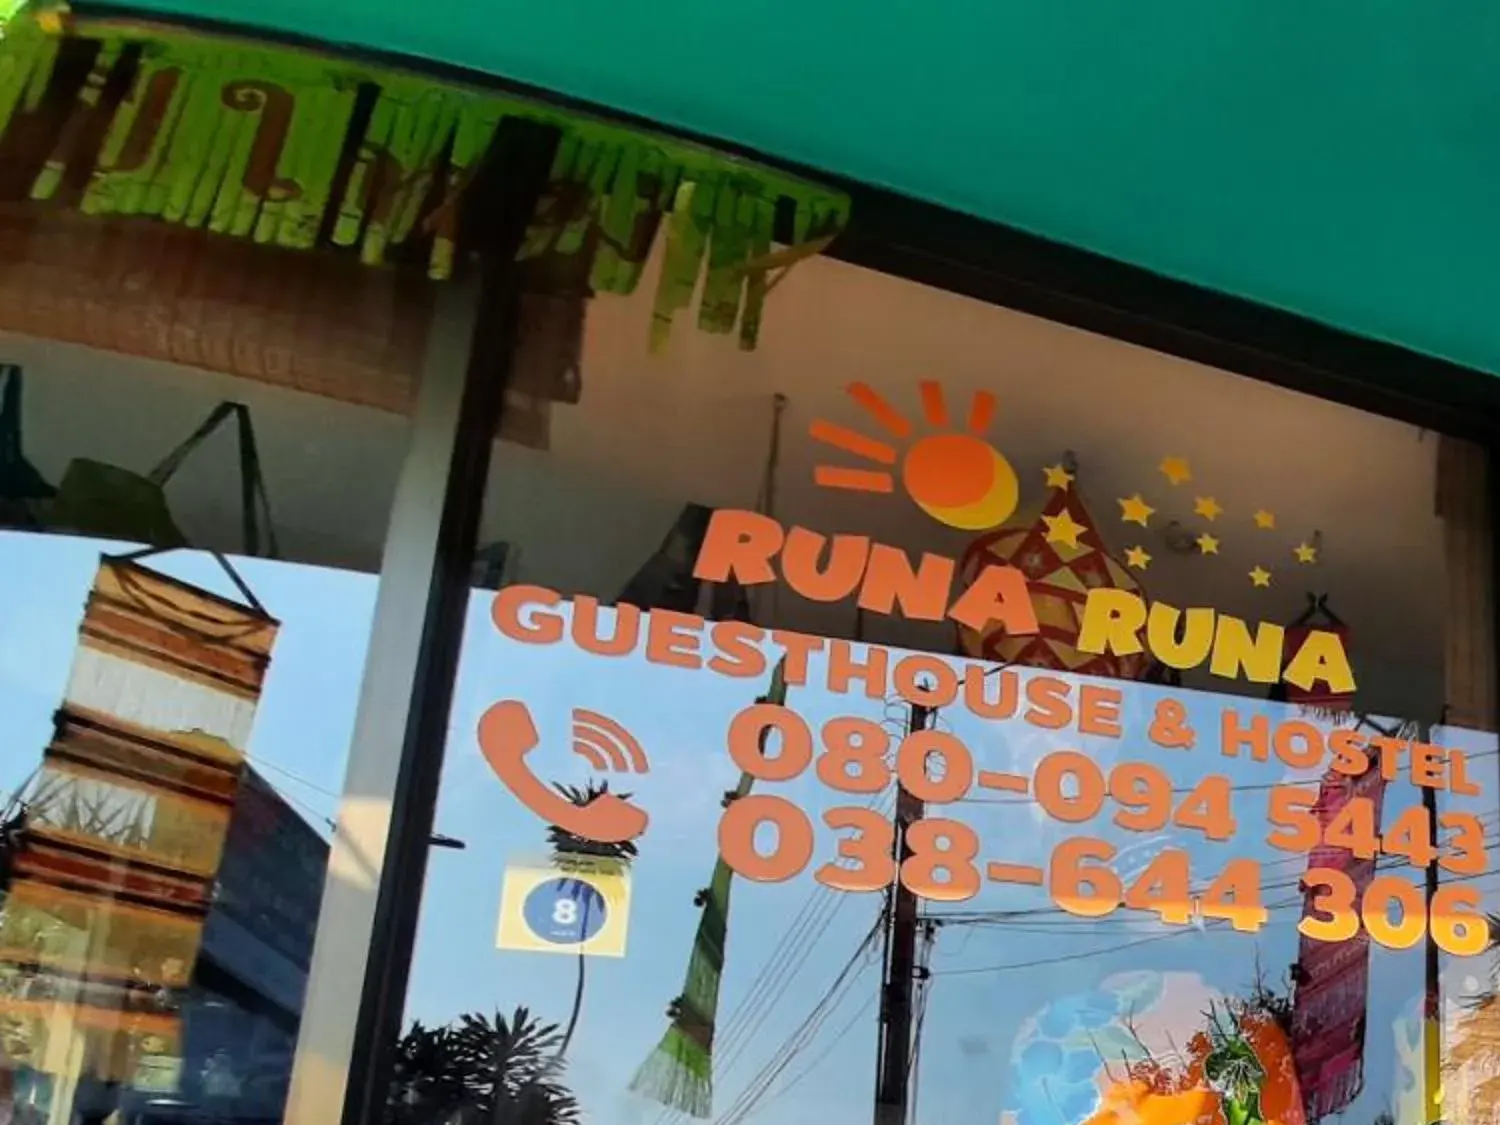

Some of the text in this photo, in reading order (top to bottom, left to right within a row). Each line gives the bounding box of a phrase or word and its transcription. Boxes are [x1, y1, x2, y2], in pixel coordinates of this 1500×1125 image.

[491, 585, 1482, 797] GUESTHOUSE & HOSTEL
[694, 509, 1356, 695] RUNA RUNA
[716, 793, 1491, 956] 038-644 306
[726, 702, 1488, 877] 080-094 5443
